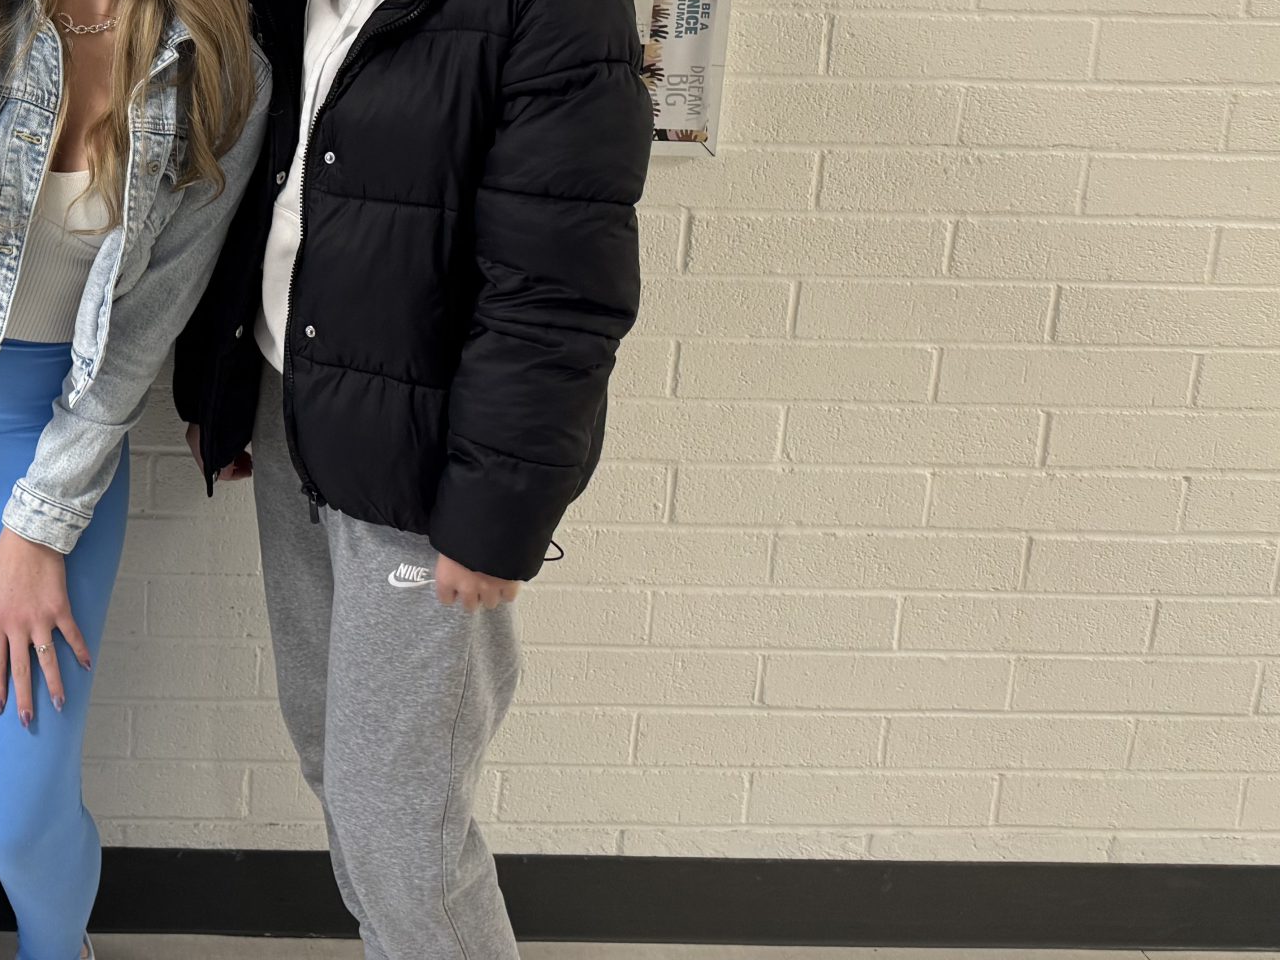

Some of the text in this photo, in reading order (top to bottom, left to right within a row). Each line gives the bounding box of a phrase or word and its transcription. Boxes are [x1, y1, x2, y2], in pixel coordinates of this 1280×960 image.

[699, 2, 711, 31] BE A
[665, 73, 688, 107] BIG
[686, 65, 706, 116] DREAM
[395, 562, 429, 581] NIKE
